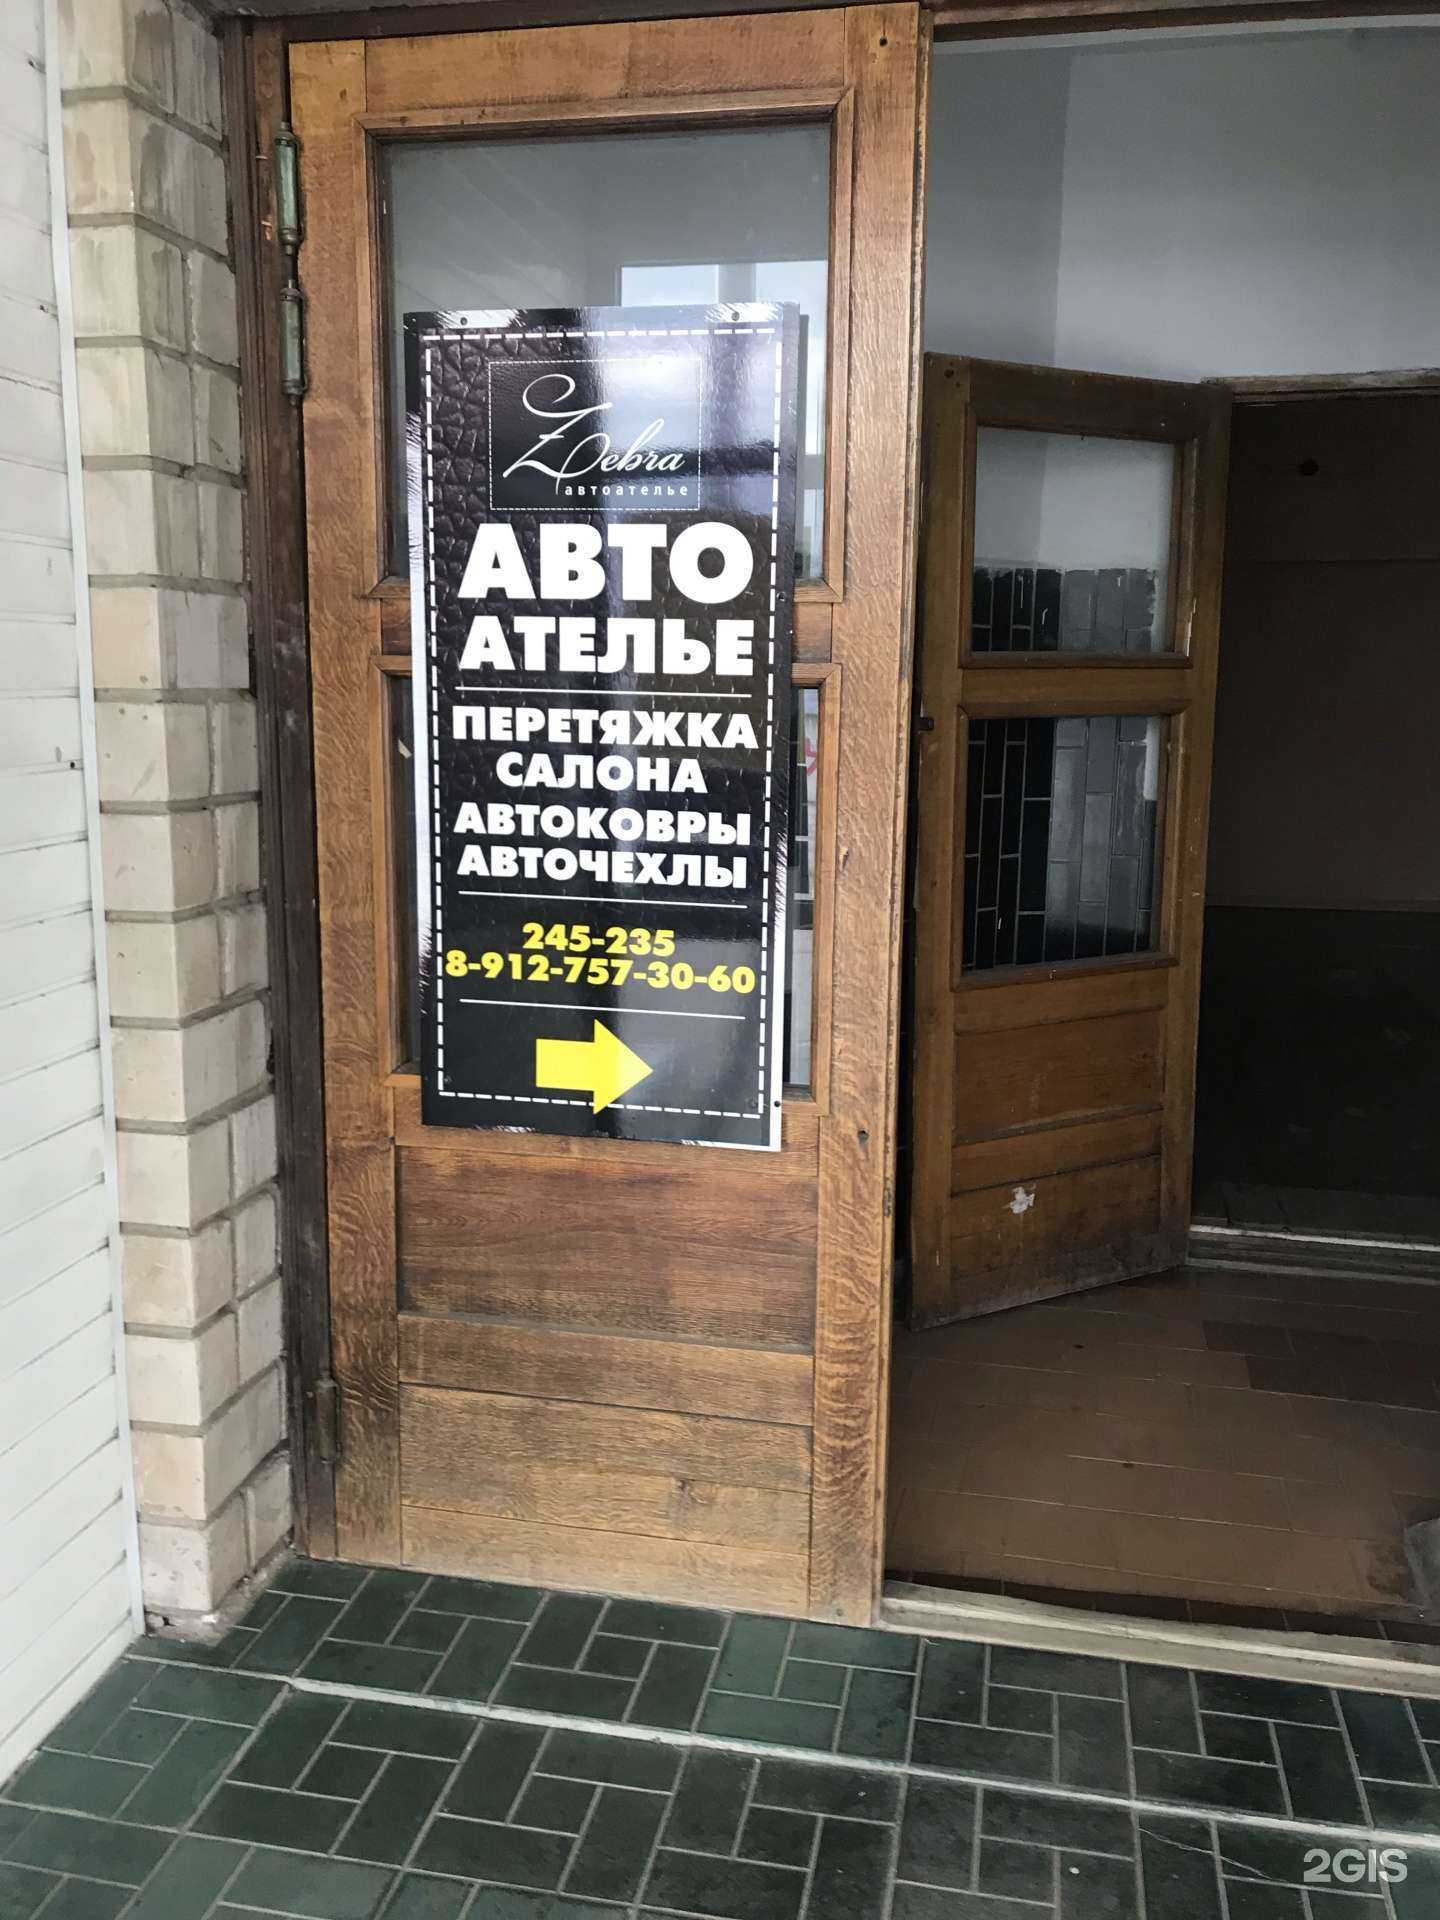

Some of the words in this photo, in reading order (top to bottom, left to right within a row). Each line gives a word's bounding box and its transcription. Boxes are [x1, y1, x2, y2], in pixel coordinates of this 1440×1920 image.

[502, 373, 686, 495] Zebra
[564, 484, 689, 497] автоателье
[457, 522, 754, 604] АВТО
[458, 615, 755, 676] АТЕЛЬЕ
[452, 706, 758, 749] ПЕРЕТЯЖКА
[496, 752, 708, 793] САЛОНА
[454, 802, 751, 846] АВТОКОВРЫ
[457, 845, 747, 888] АВТОЧЕХЛЫ
[522, 922, 676, 956] 245-235
[445, 950, 755, 994] 8-912-757-30-60
